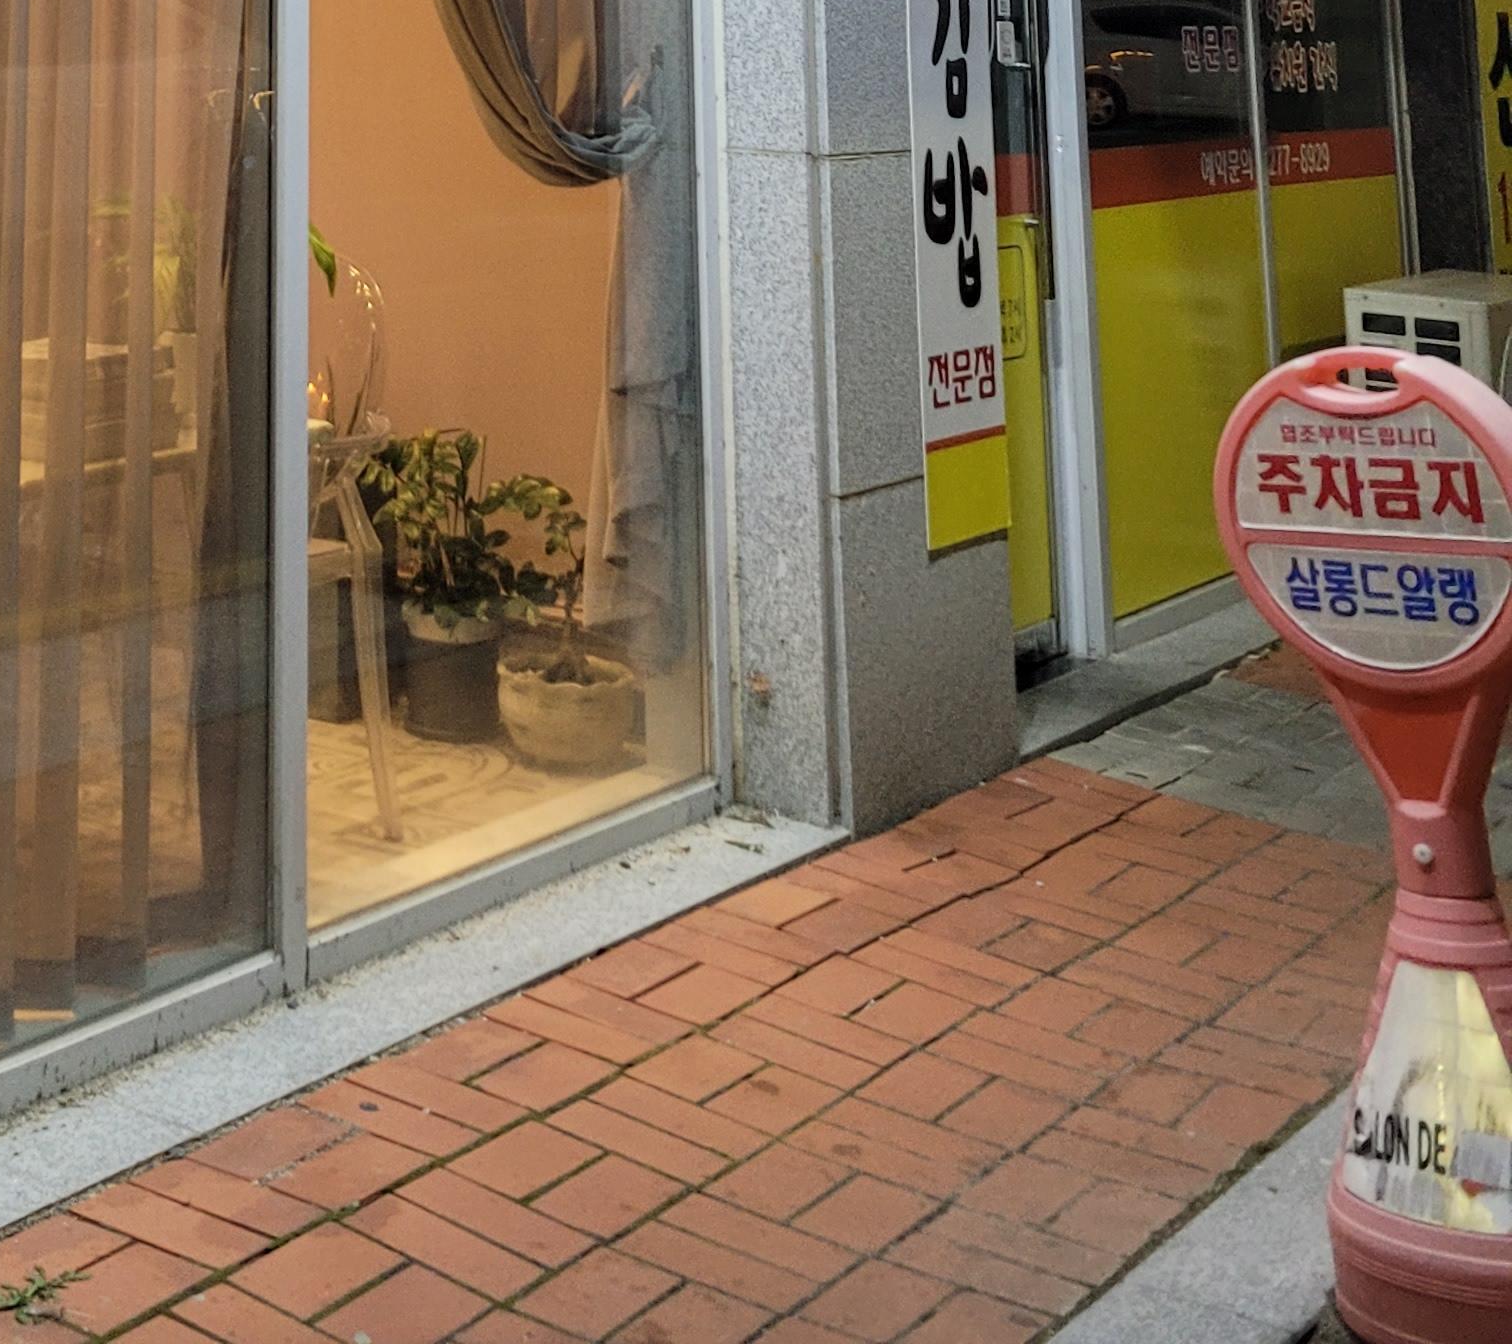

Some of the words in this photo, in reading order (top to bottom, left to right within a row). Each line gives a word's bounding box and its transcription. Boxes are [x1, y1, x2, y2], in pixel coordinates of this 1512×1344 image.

[1181, 24, 1241, 74] 전문점
[926, 343, 997, 410] 전문점
[1256, 453, 1486, 524] 주차금지
[1285, 556, 1481, 626] 살롱드알랭
[1417, 1120, 1448, 1176] DE
